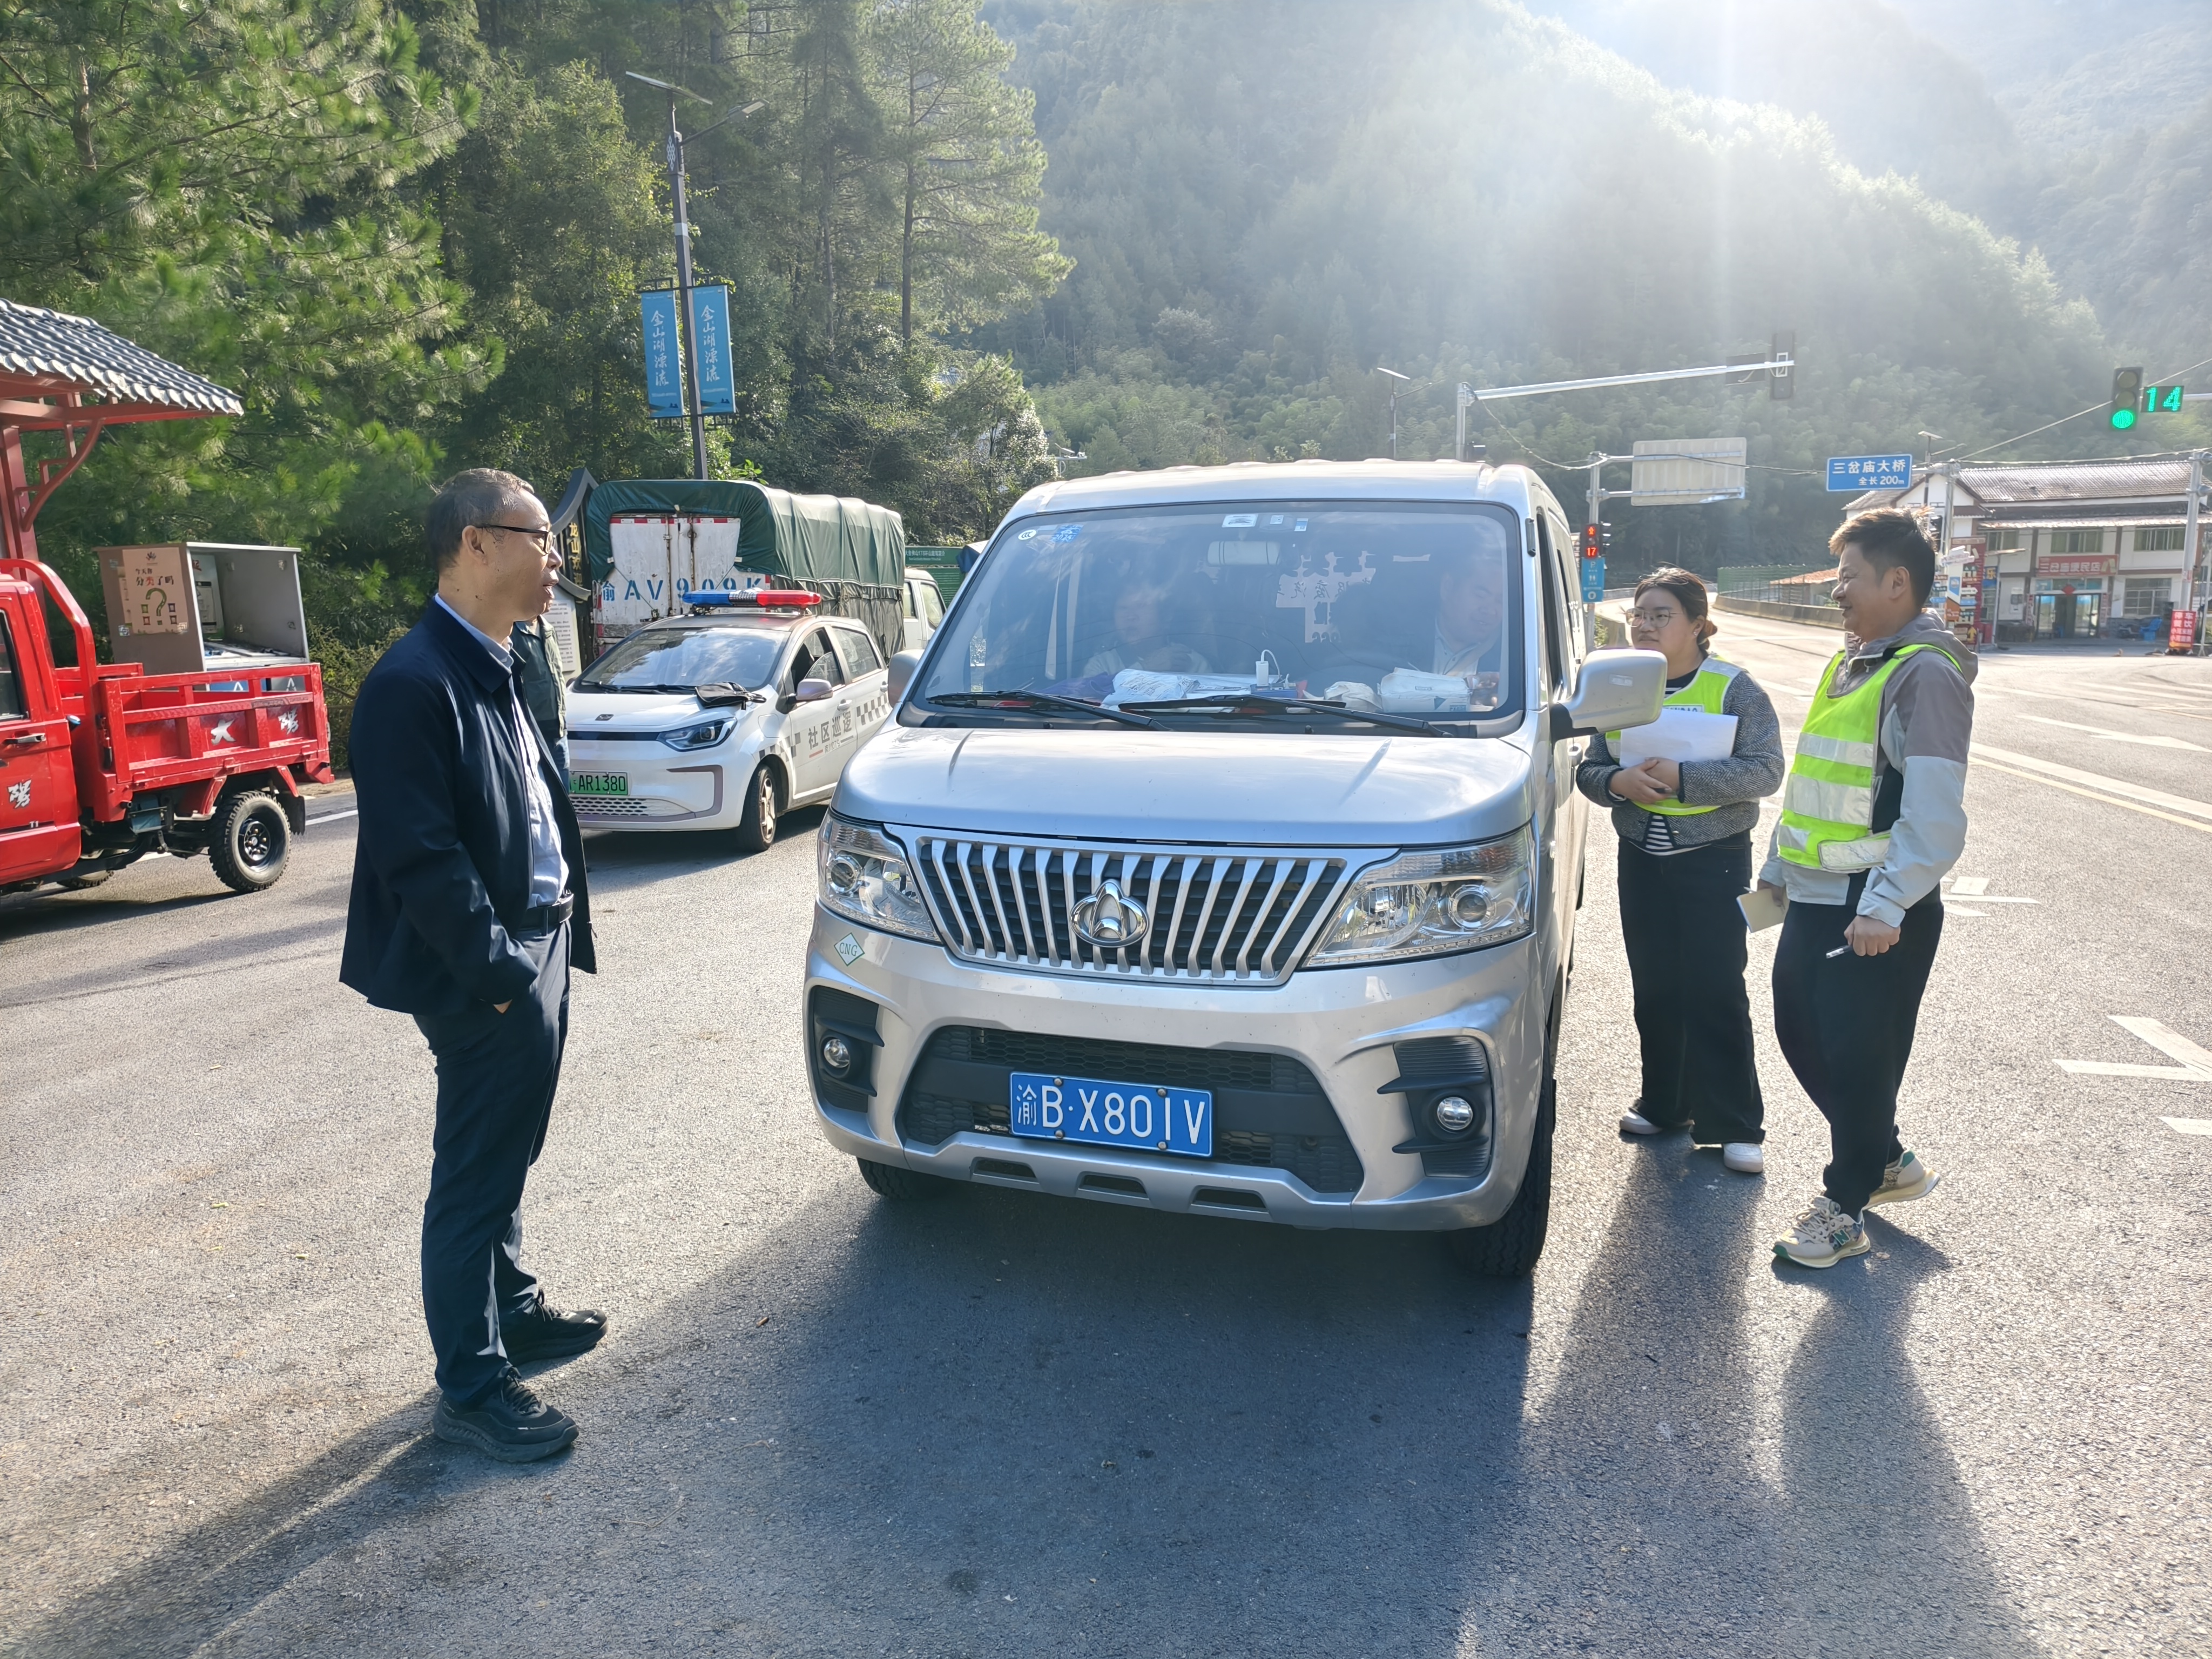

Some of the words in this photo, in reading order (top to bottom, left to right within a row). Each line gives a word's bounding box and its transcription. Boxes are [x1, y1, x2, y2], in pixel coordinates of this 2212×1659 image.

[651, 310, 669, 387] 金山湖漂流
[701, 305, 720, 382] 金山湖漂流
[2147, 387, 2181, 412] 14
[1832, 459, 1906, 474] 三岔庙大桥
[1587, 547, 1596, 556] 17
[136, 576, 174, 586] 分类了吗
[211, 719, 236, 745] 大
[808, 711, 852, 750] 社区巡逻
[570, 774, 626, 792] AR1380
[839, 942, 858, 957] CNG
[1832, 1229, 1851, 1246] N
